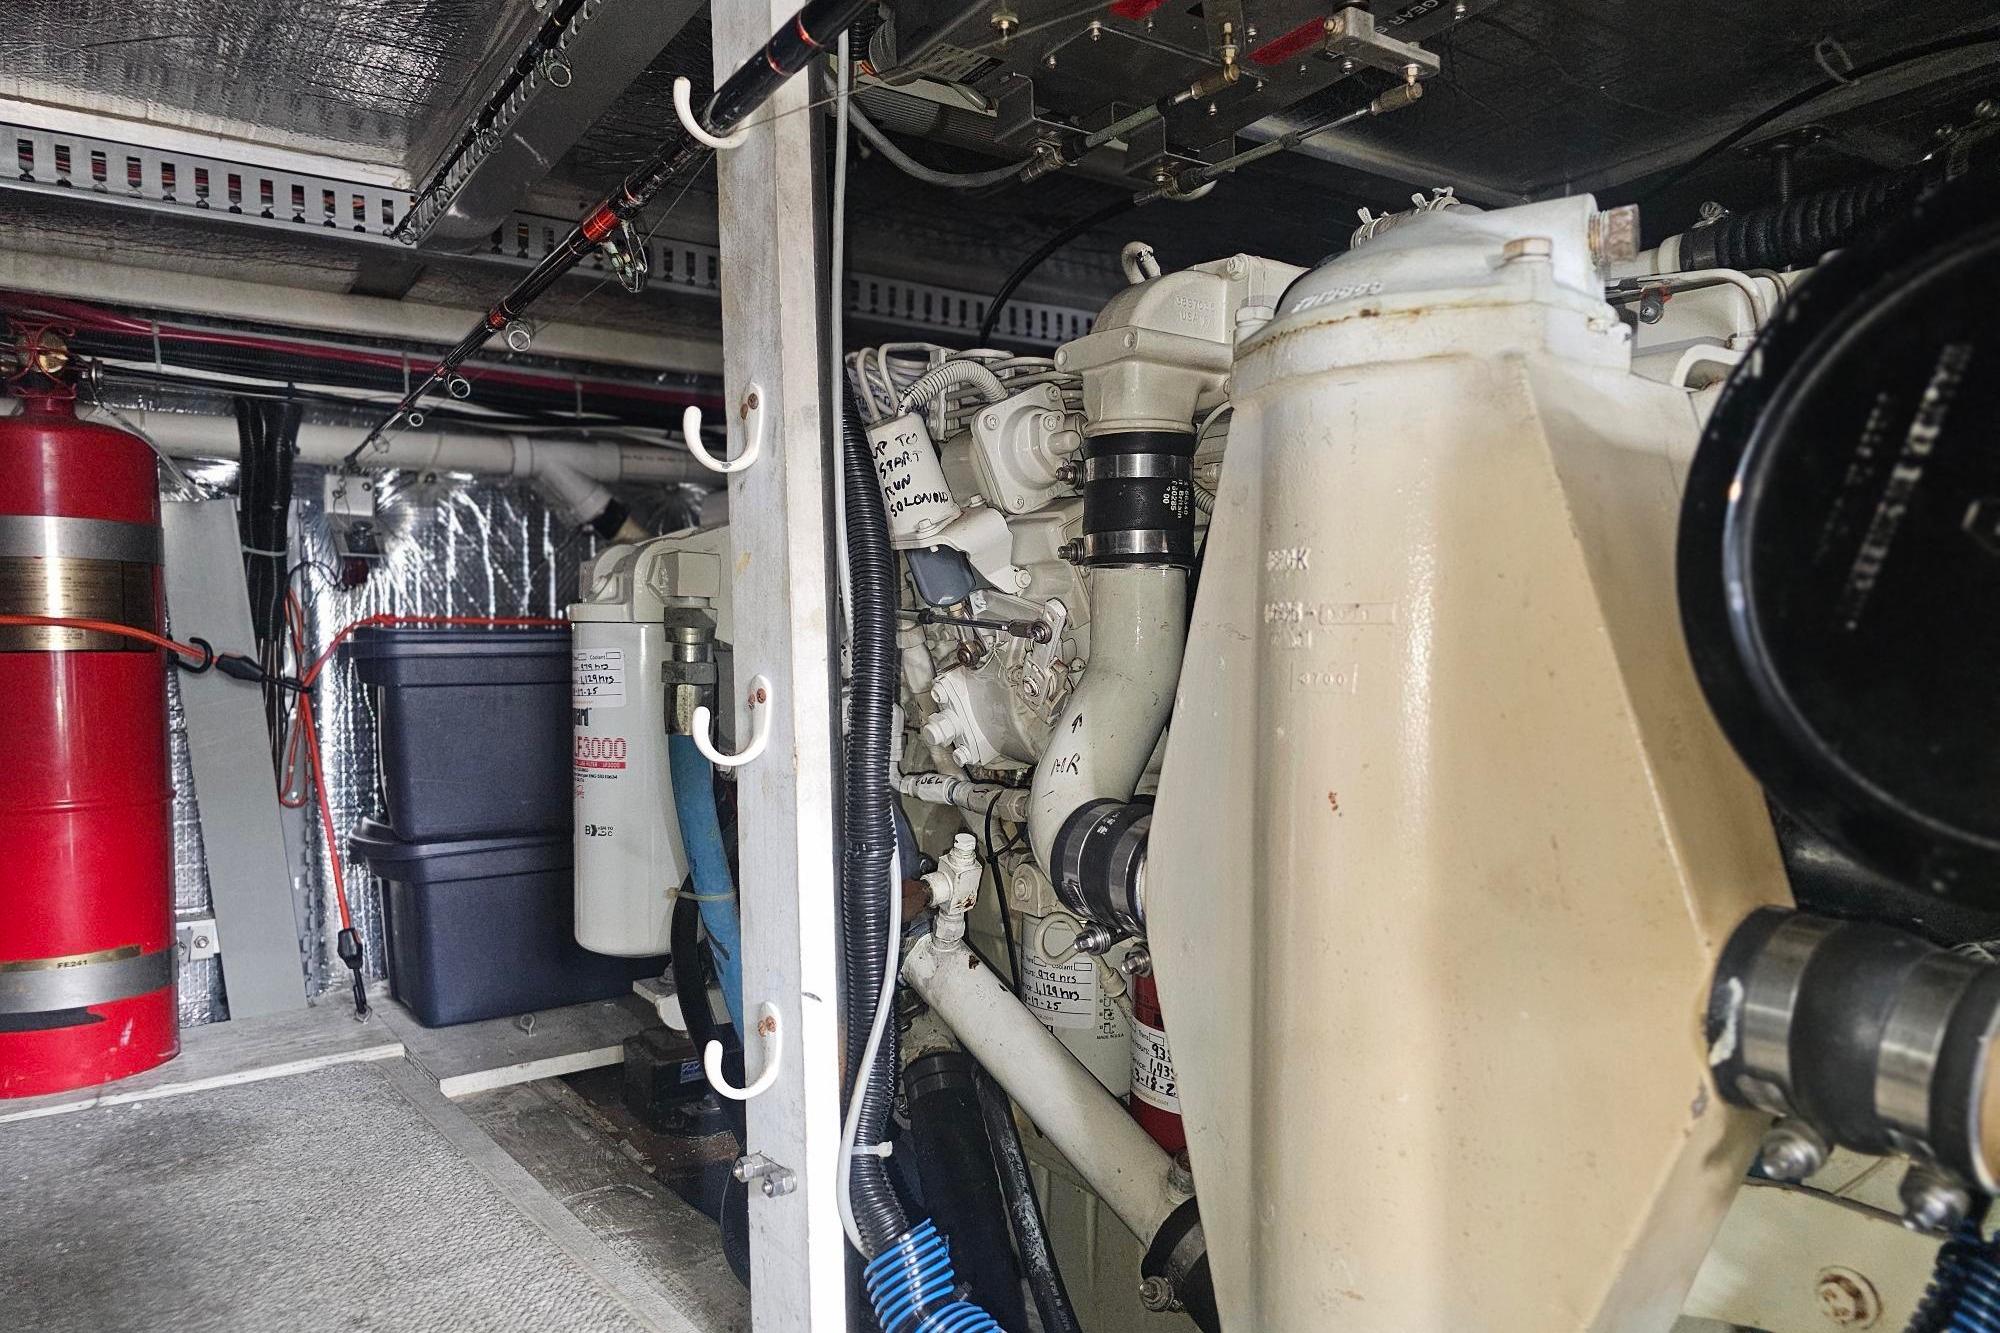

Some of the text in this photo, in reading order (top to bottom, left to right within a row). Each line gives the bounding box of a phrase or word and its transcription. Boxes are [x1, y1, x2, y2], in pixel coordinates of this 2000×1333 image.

[1388, 0, 1439, 25] GEAR
[879, 450, 923, 479] START
[884, 474, 911, 501] RUN
[915, 776, 943, 786] FUEL
[1059, 974, 1077, 984] hrs
[1135, 1068, 1177, 1097] 3-18-2
